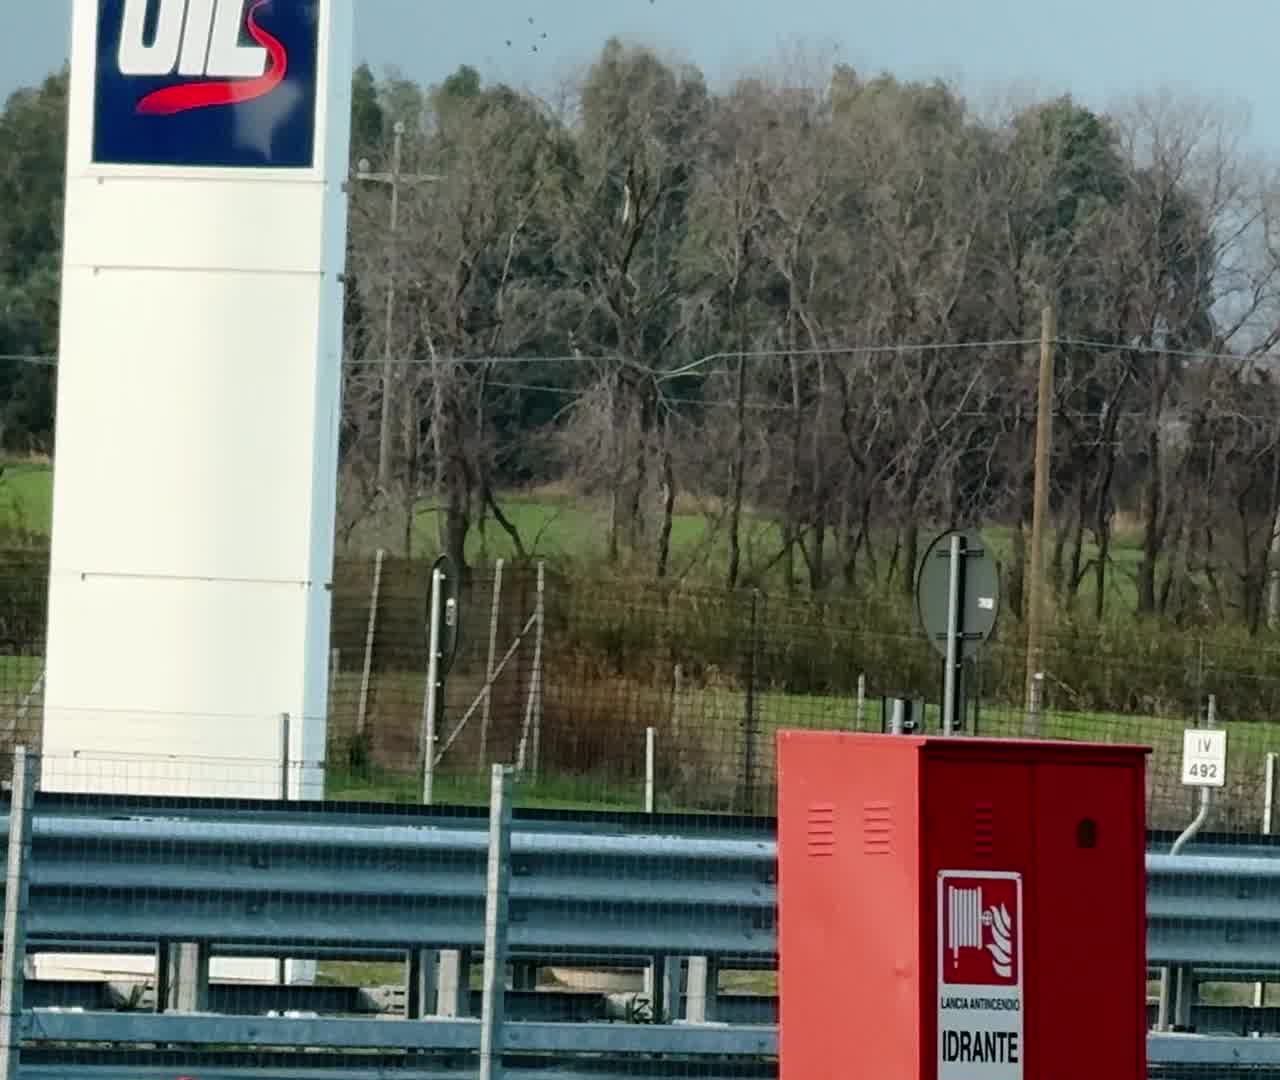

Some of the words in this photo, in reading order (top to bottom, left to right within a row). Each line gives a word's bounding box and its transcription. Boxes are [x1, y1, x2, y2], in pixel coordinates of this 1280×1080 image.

[1198, 737, 1212, 752] IV
[1189, 763, 1217, 778] 492
[941, 996, 969, 1009] LANCIA
[942, 1030, 1018, 1063] IDRANTE
